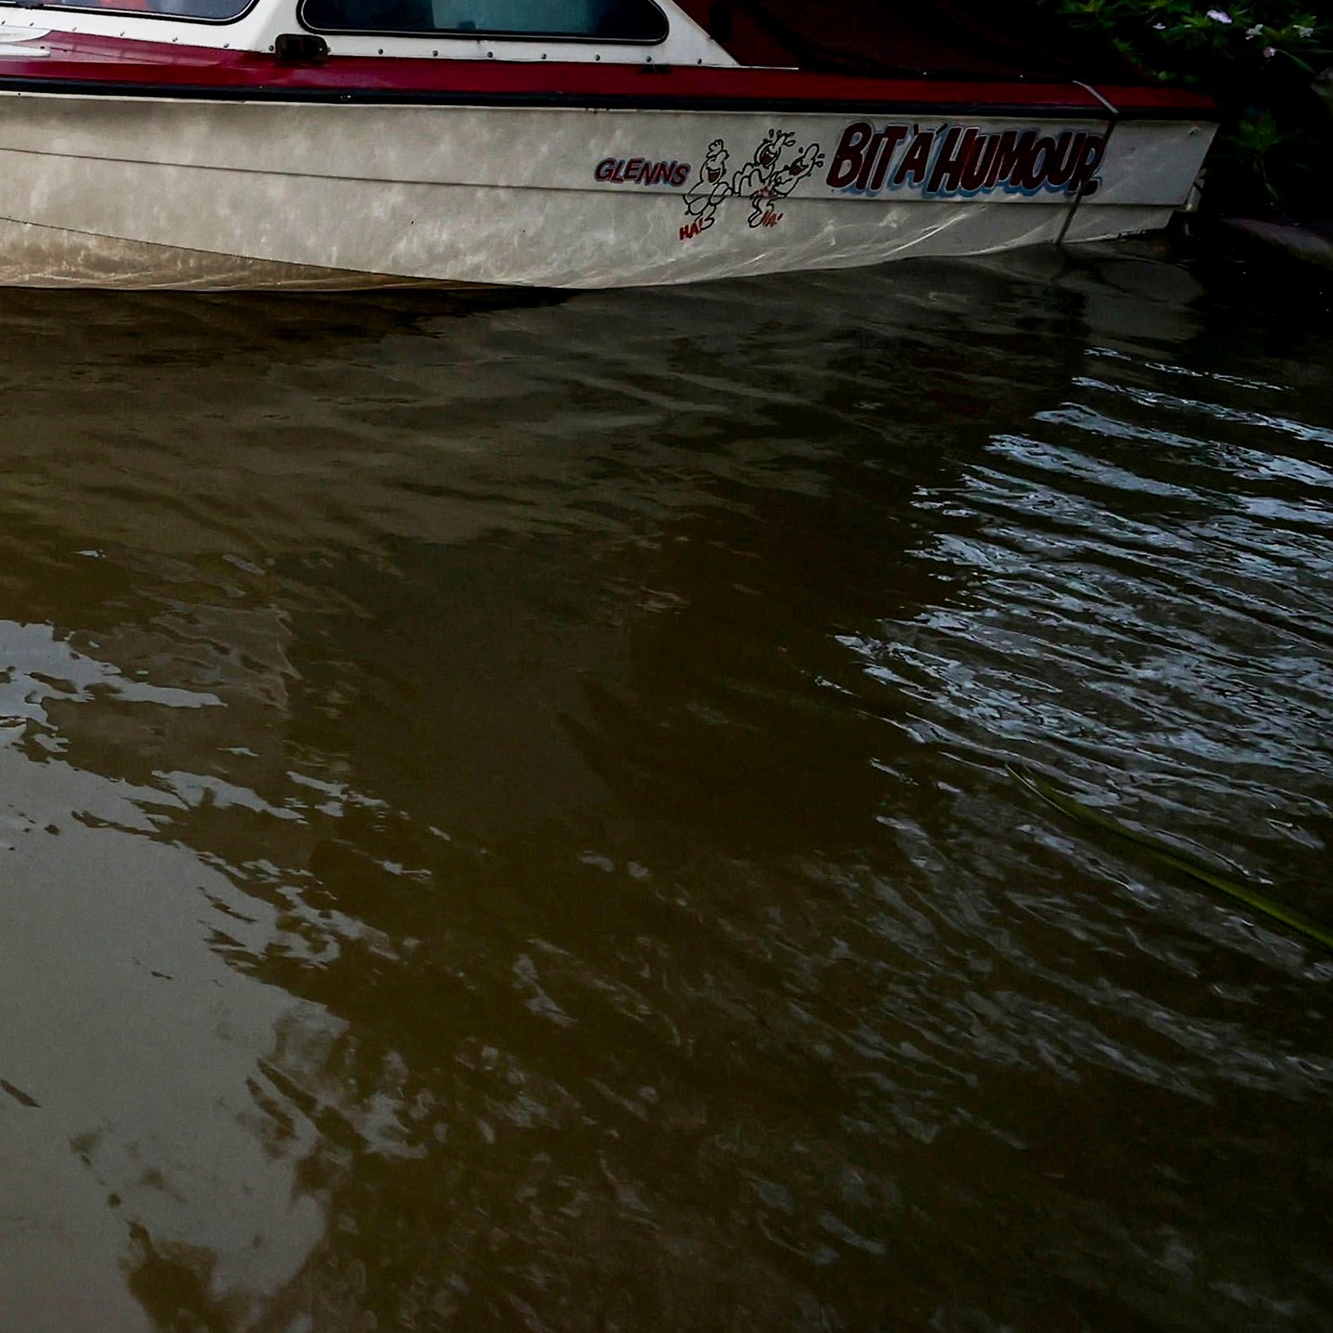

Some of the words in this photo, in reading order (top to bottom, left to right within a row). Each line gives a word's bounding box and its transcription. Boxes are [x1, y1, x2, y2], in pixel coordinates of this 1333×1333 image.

[594, 157, 691, 188] GLENNS
[826, 122, 909, 192] BIT
[926, 126, 1105, 196] HUMOUR
